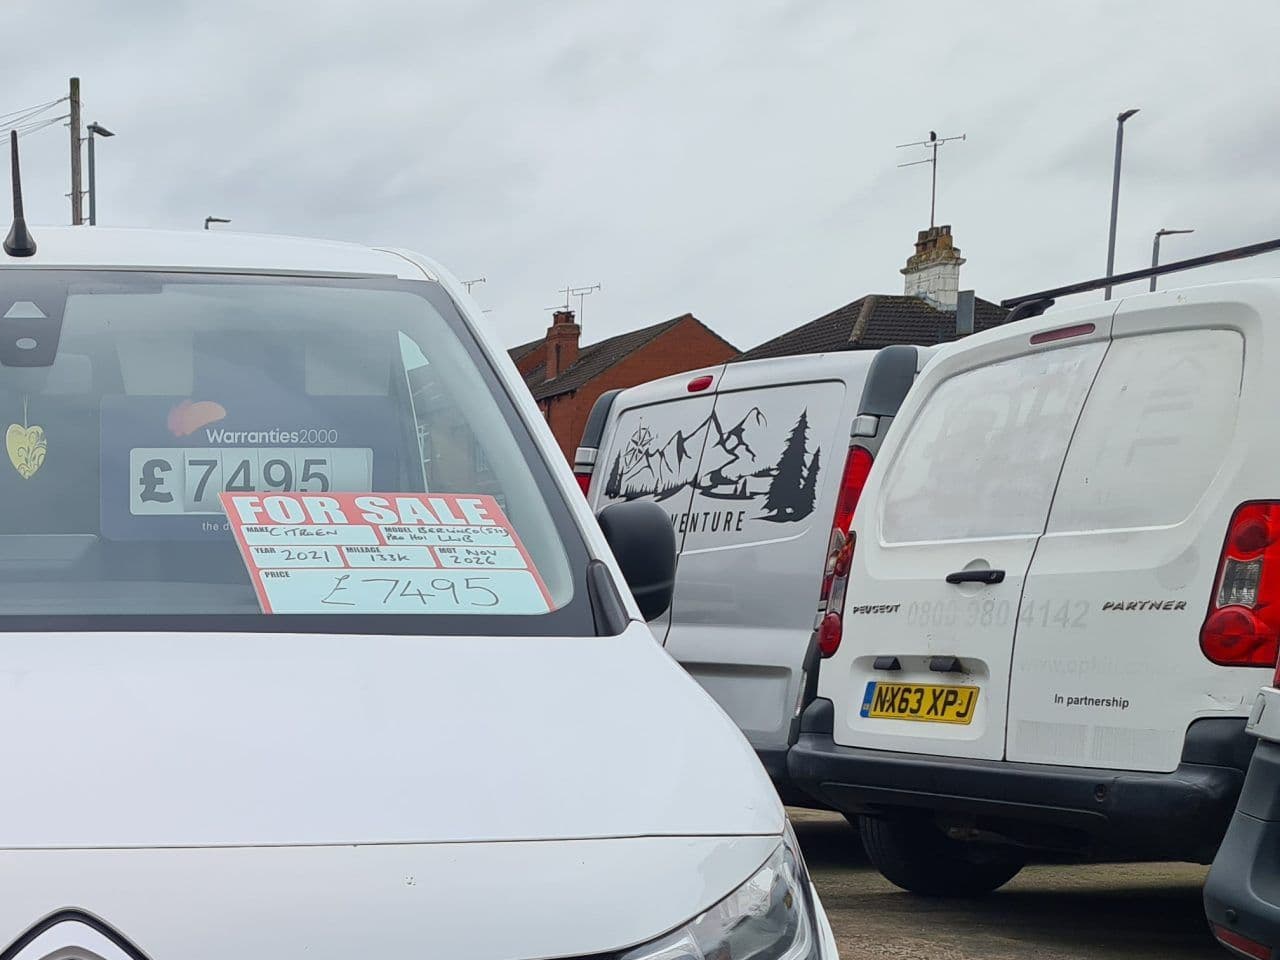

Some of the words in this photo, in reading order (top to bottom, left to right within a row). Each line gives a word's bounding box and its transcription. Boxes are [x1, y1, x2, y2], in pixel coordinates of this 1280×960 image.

[205, 427, 339, 445] Warranties2000
[139, 457, 330, 504] £7495
[231, 496, 350, 525] FOR
[354, 496, 497, 526] SALE
[280, 549, 331, 563] 2021
[264, 570, 291, 578] PRICE
[320, 573, 500, 607] £7495
[852, 603, 901, 615] PEUGEOT
[1020, 599, 1091, 628] 4142
[1101, 599, 1188, 612] PARTNER
[872, 684, 925, 715] NX63
[926, 688, 975, 718] XPJ
[1054, 693, 1064, 704] In
[1066, 695, 1130, 710] partnership
